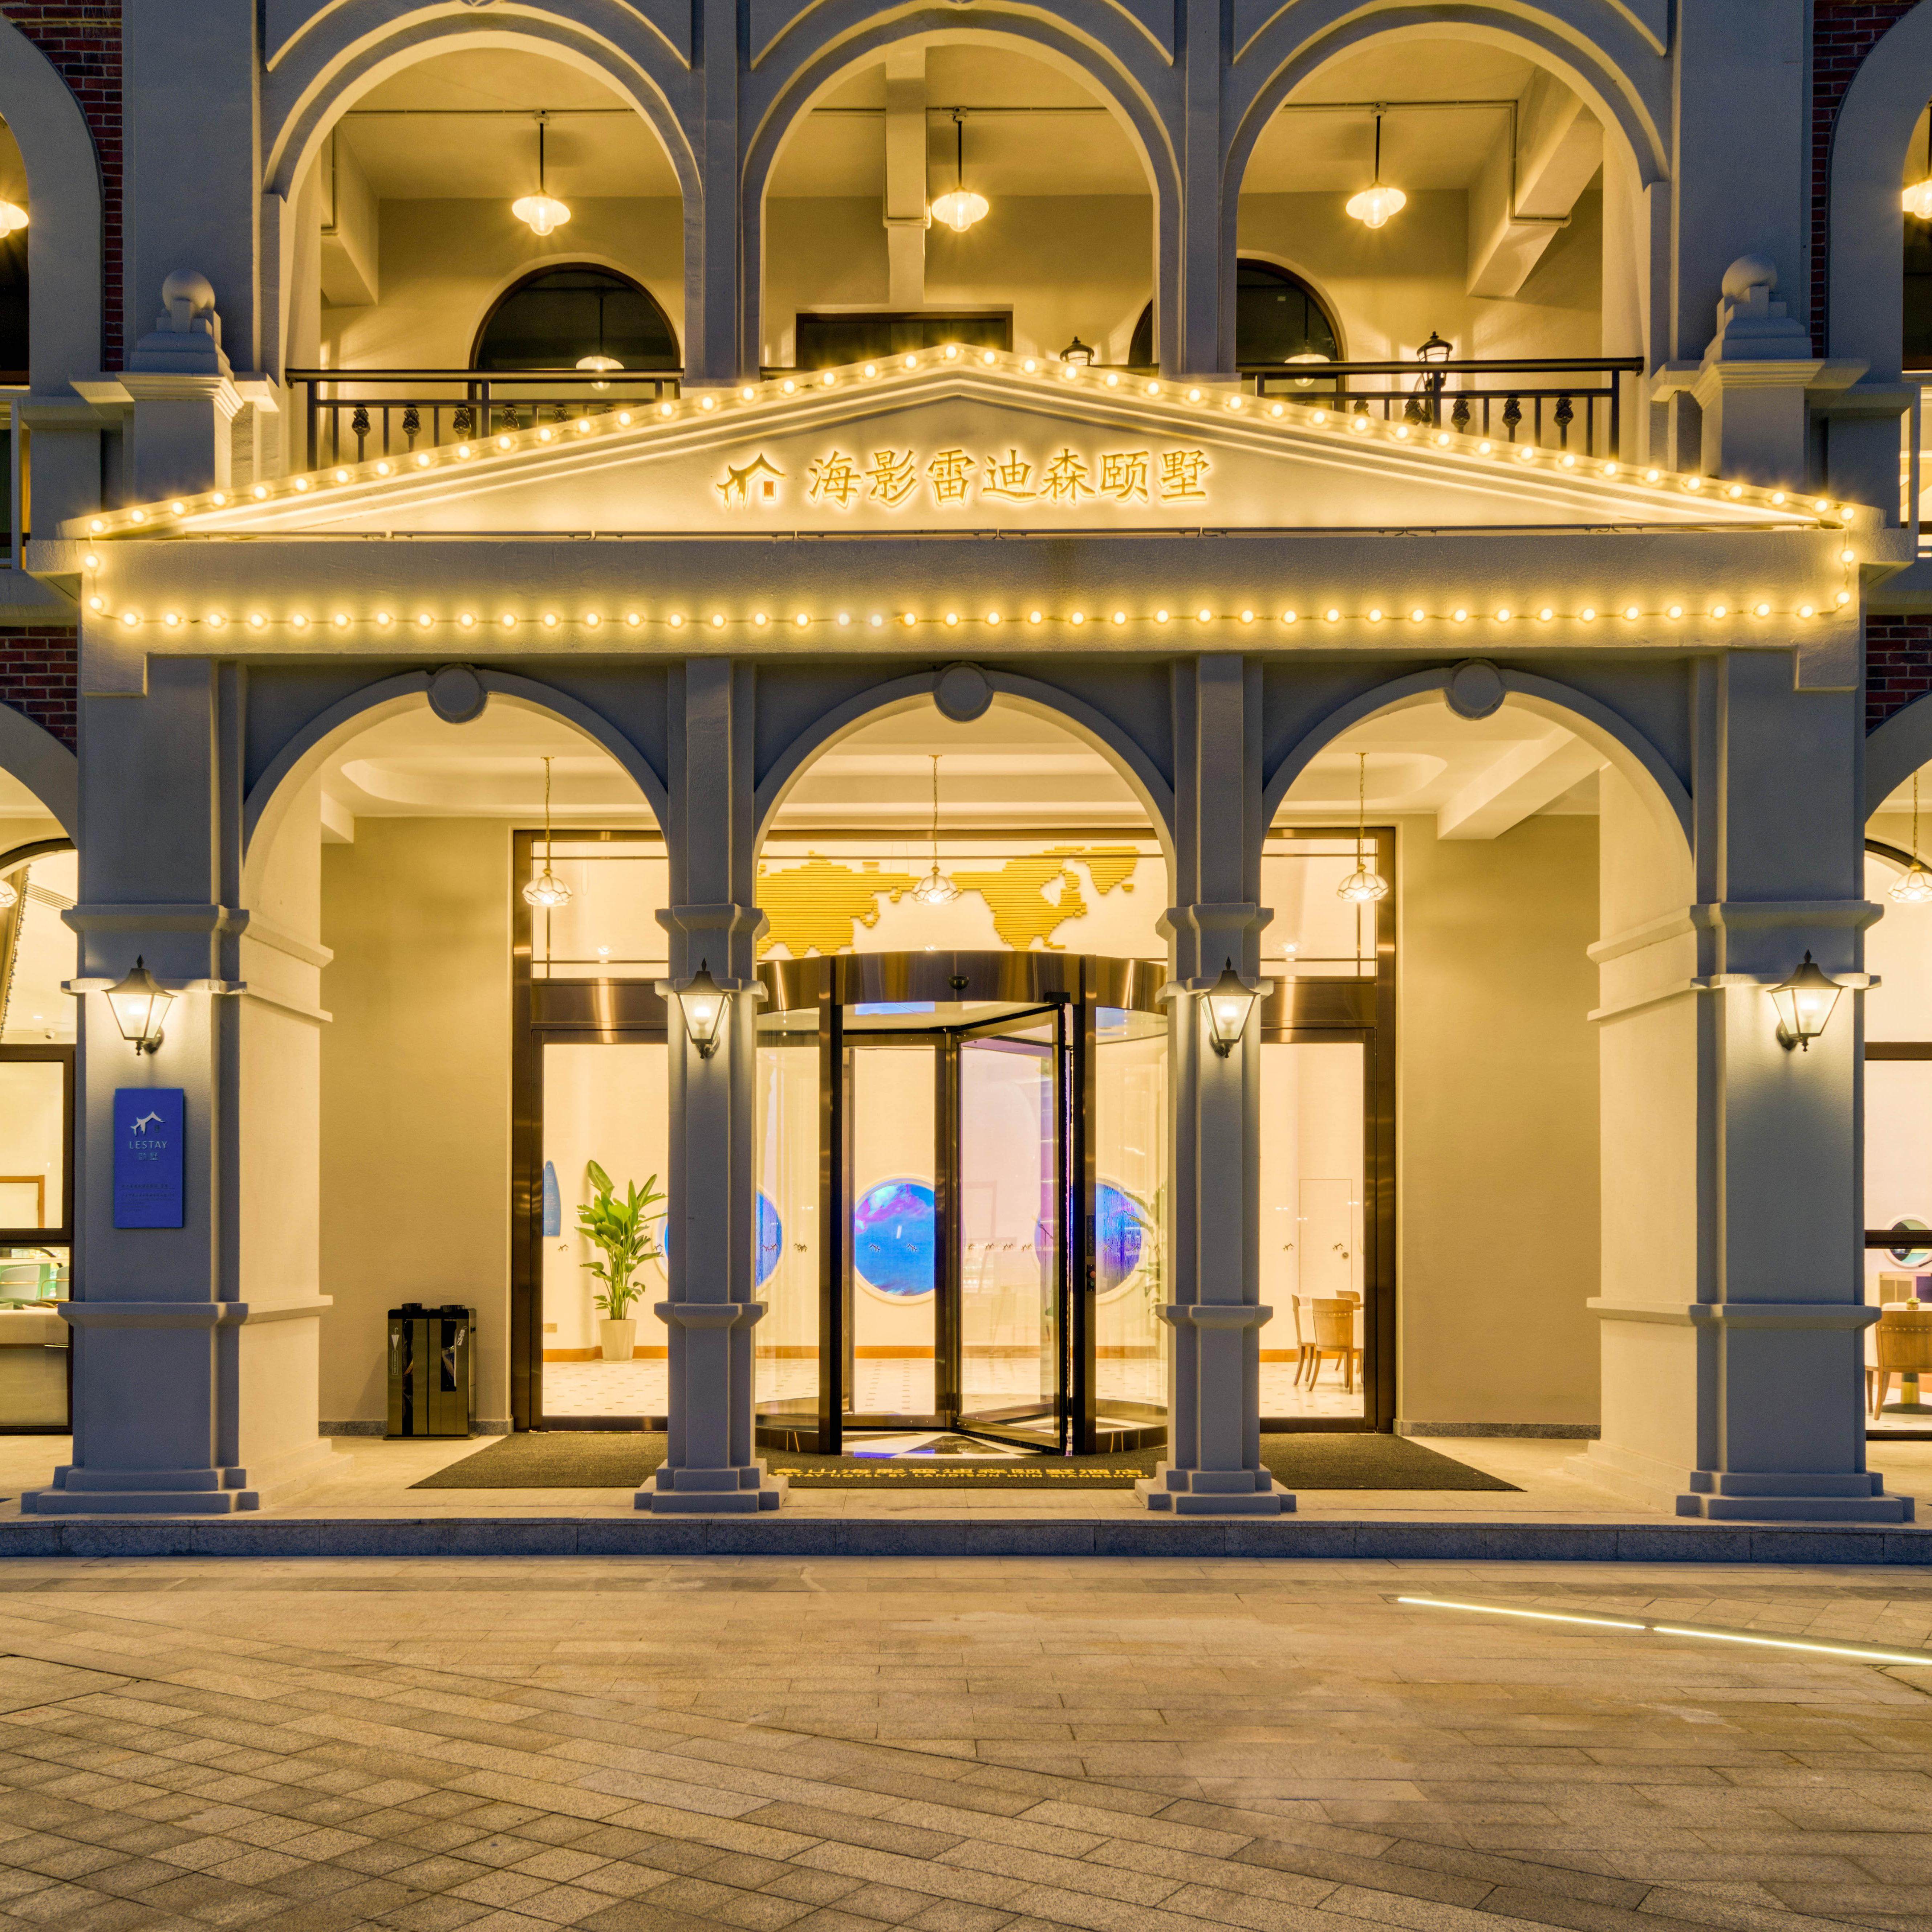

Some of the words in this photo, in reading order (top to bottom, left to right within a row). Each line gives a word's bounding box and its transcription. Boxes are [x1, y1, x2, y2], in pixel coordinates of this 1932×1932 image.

[808, 448, 1210, 506] 海影雷迪森颐墅
[130, 1141, 167, 1149] LESTAY
